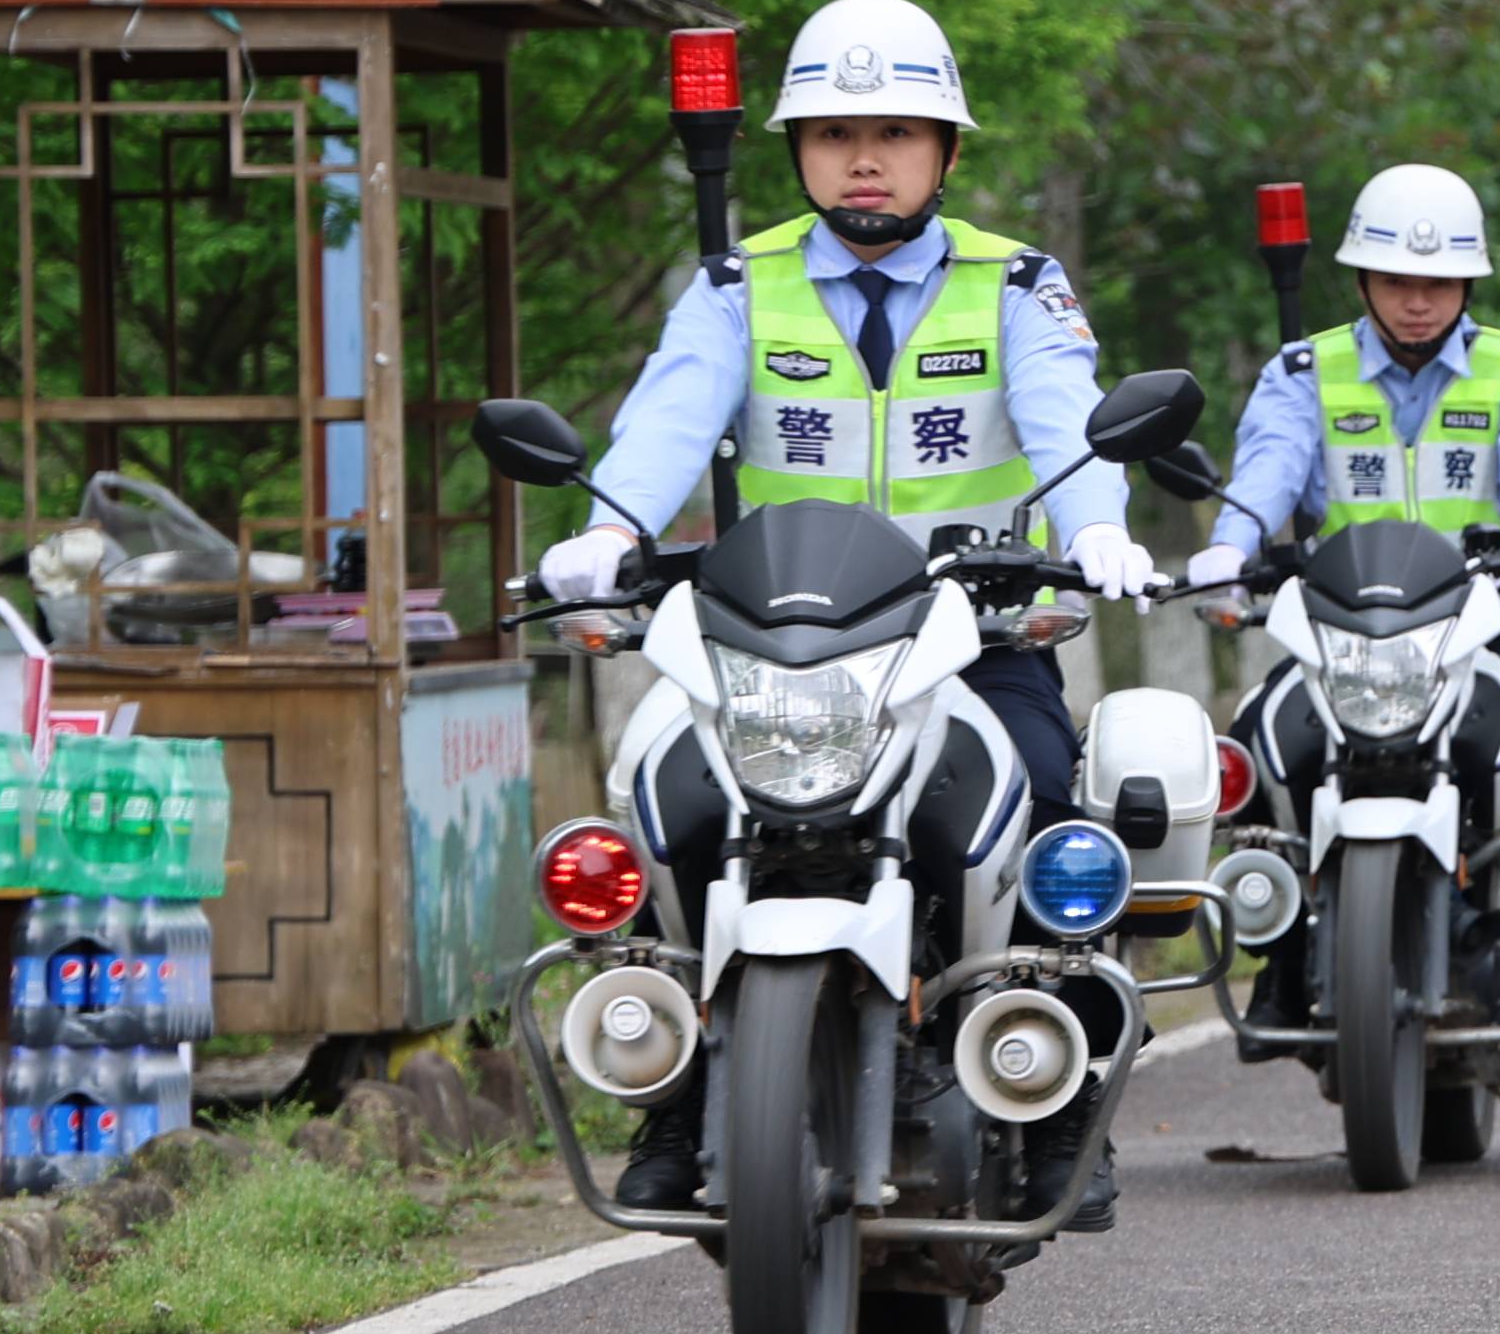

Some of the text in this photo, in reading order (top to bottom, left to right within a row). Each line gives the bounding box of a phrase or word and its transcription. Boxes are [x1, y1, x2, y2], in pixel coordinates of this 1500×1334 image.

[920, 351, 982, 373] 022724
[776, 406, 970, 466] 警 察
[1348, 448, 1476, 497] 警 察
